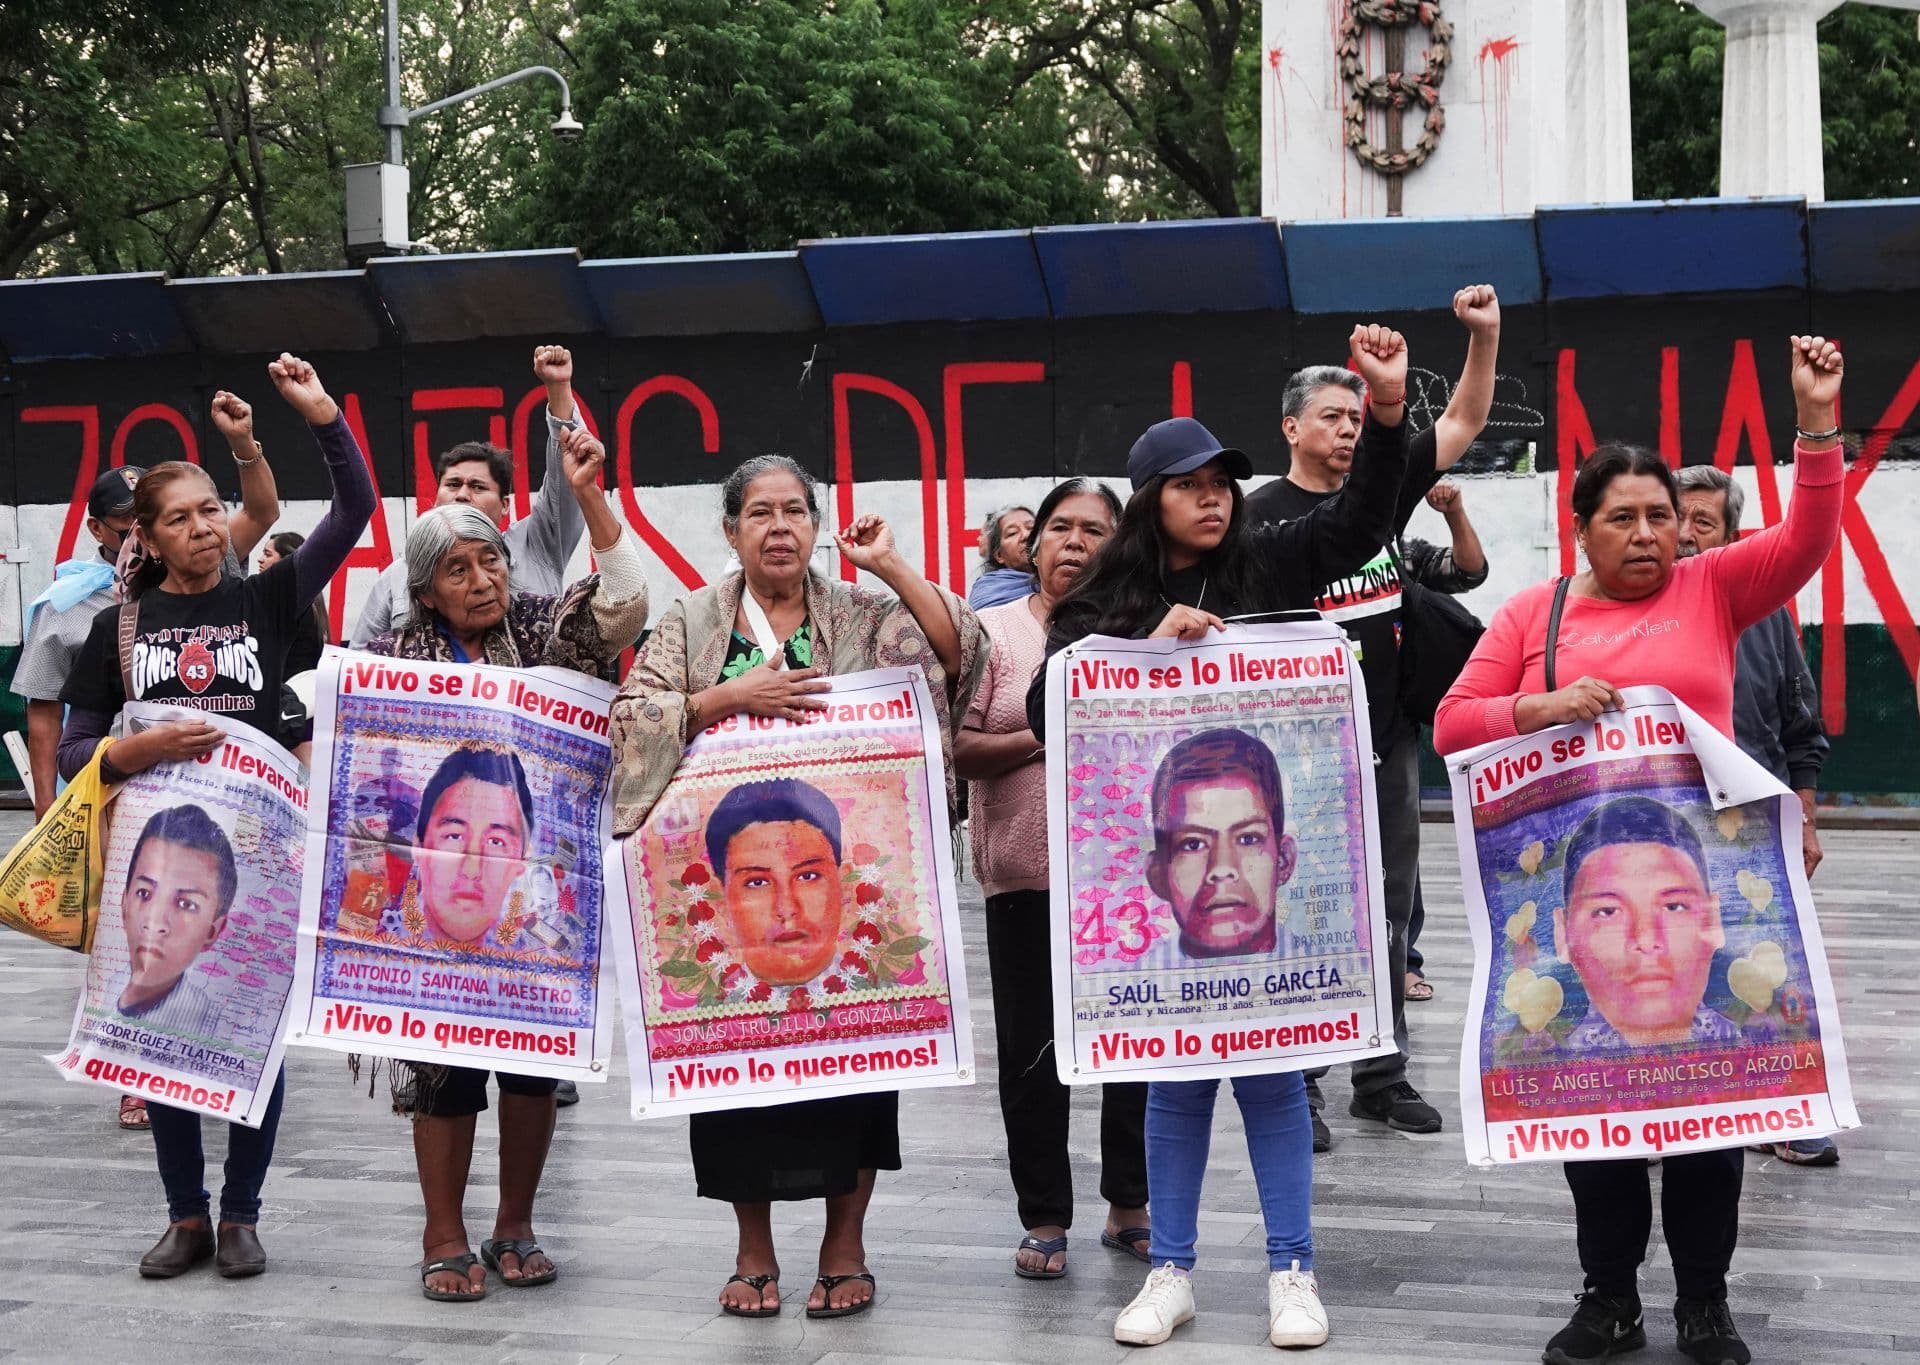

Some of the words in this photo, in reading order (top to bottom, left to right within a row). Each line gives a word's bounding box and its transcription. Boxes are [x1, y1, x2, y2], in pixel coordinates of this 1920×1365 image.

[1564, 629, 1632, 647] Calvin
[1632, 617, 1680, 638] Klein
[132, 642, 177, 700] ONCE
[186, 664, 209, 680] 43
[216, 635, 264, 691] AÑOS
[344, 662, 419, 694] ¡Vivo
[428, 674, 463, 696] se
[471, 672, 499, 700] lo
[1072, 660, 1140, 698] ¡Vivo
[1148, 666, 1182, 689] se
[1191, 656, 1221, 686] lo
[1229, 646, 1345, 682] llevaron!
[190, 692, 256, 712] sombras
[704, 712, 738, 735] se
[748, 712, 775, 731] lo
[786, 690, 914, 728] evaron!
[1074, 710, 1091, 720] Yo,
[1097, 709, 1113, 717] Jan
[1238, 700, 1267, 713] quiero
[1271, 697, 1294, 708] saber
[221, 743, 310, 811] llevaron!
[1475, 756, 1543, 804] ¡Vivo
[1551, 735, 1586, 763] se
[1594, 722, 1626, 752] lo
[1634, 714, 1686, 747] llev
[1289, 886, 1305, 900] MI
[1309, 881, 1359, 898] QUERIDO
[1304, 899, 1340, 915] TIGRE
[1076, 900, 1152, 956] 43
[338, 962, 411, 985] ANTONIO
[420, 971, 489, 995] SANTANA
[497, 982, 572, 1004] MAESTRO
[353, 983, 364, 991] de
[420, 990, 447, 1001] Nieto
[450, 993, 460, 1003] de
[1108, 979, 1165, 1006] SAÚL
[1181, 977, 1251, 1002] BRUNO
[1264, 964, 1342, 995] GARCÍA
[323, 1003, 393, 1035] ¡Vivo
[401, 1011, 426, 1039] lo
[434, 1022, 576, 1058] queremos!
[673, 1021, 727, 1043] JONÁS
[738, 1013, 826, 1037] TRUJILLO
[837, 1002, 926, 1027] GONZÁLEZ
[872, 1026, 881, 1034] El
[1077, 1011, 1099, 1022] Hijo
[1103, 1009, 1115, 1018] de
[1120, 1007, 1141, 1017] Saúl
[1147, 1008, 1154, 1018] y
[1158, 1004, 1202, 1016] Nicanora
[1218, 1002, 1228, 1011] 18
[1233, 999, 1254, 1010] años
[100, 1020, 174, 1052] RODRÍGUEZ
[180, 1043, 246, 1074] TLATEMPA
[1091, 1032, 1166, 1069] ¡Vivo
[1175, 1029, 1202, 1057] lo
[1211, 1012, 1360, 1060] queremos!
[84, 1056, 236, 1113] queremos!
[666, 1060, 740, 1098] ¡Vivo
[747, 1057, 776, 1084] lo
[784, 1039, 939, 1086] queremos!
[1491, 1074, 1540, 1097] LUÍS
[1551, 1071, 1614, 1092] ÁNGEL
[1627, 1060, 1734, 1087] FRANCISCO
[1744, 1052, 1817, 1076] ARZOLA
[1518, 1098, 1541, 1109] Hijo
[1546, 1096, 1557, 1105] de
[1562, 1092, 1601, 1104] Lorenzo
[1606, 1092, 1613, 1101] y
[1617, 1088, 1657, 1101] Benigna
[1723, 1079, 1741, 1090] San
[1507, 1123, 1590, 1159] ¡Vivo
[1600, 1118, 1632, 1148] lo
[1642, 1099, 1815, 1152] queremos!
